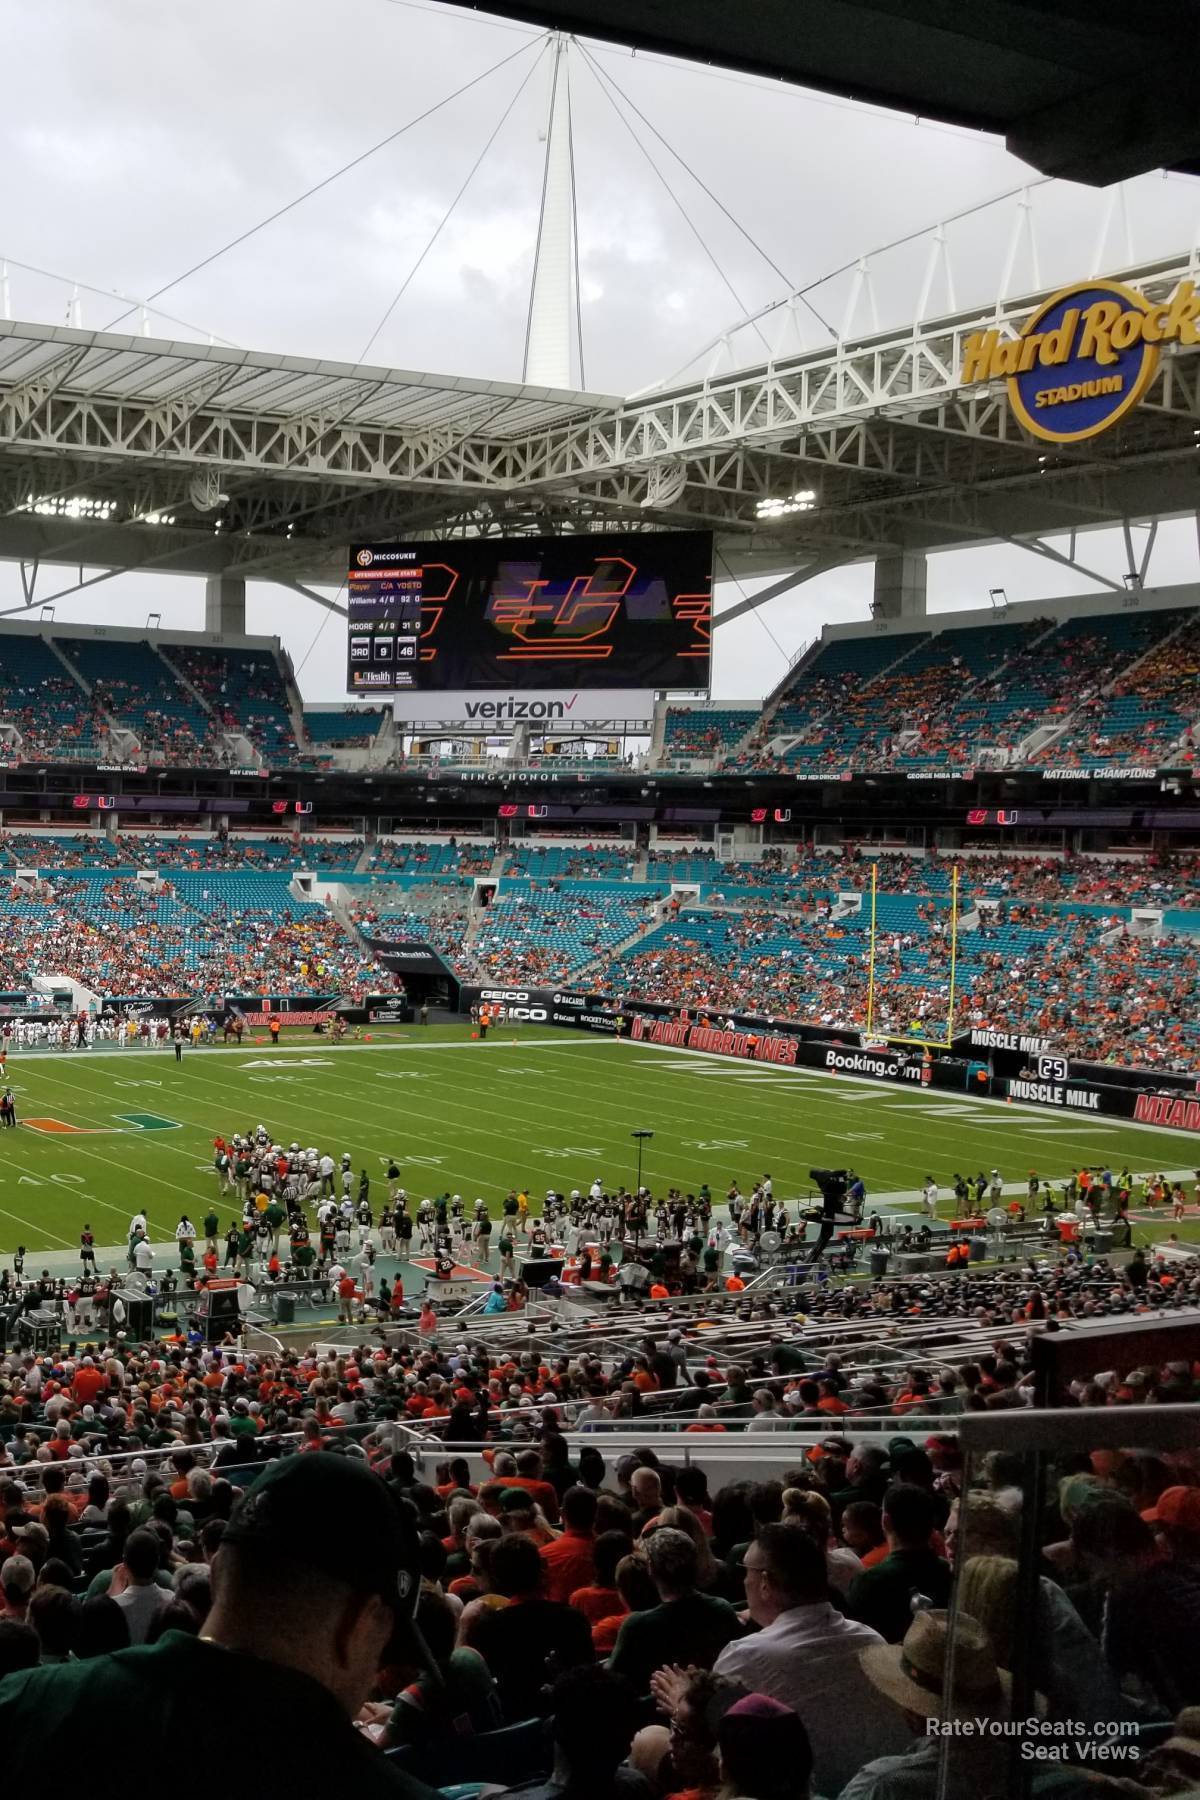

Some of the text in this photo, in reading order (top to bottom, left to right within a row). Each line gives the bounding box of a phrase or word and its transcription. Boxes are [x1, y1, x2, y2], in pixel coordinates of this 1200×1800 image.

[961, 280, 1200, 385] Hard Rock
[1035, 375, 1123, 408] STADIUM
[374, 552, 416, 560] MICCOSUKEE
[380, 582, 394, 590] C/A
[348, 622, 373, 631] MOORE
[351, 646, 413, 657] 3RD 9 46
[464, 696, 564, 719] verizon
[461, 773, 559, 781] RING HONOR
[1043, 768, 1157, 779] NATIONAL CHAMPIONS
[480, 990, 529, 1000] GEICO
[580, 1014, 601, 1024] ROCKET
[971, 1029, 1018, 1050] MUSCLE
[238, 1058, 336, 1067] ACC
[1043, 1060, 1064, 1077] 25
[1009, 1079, 1100, 1109] MUSCLE MILK
[534, 1233, 546, 1242] 95
[440, 1260, 452, 1271] 22
[45, 1283, 54, 1292] 71
[83, 1283, 93, 1293] 66
